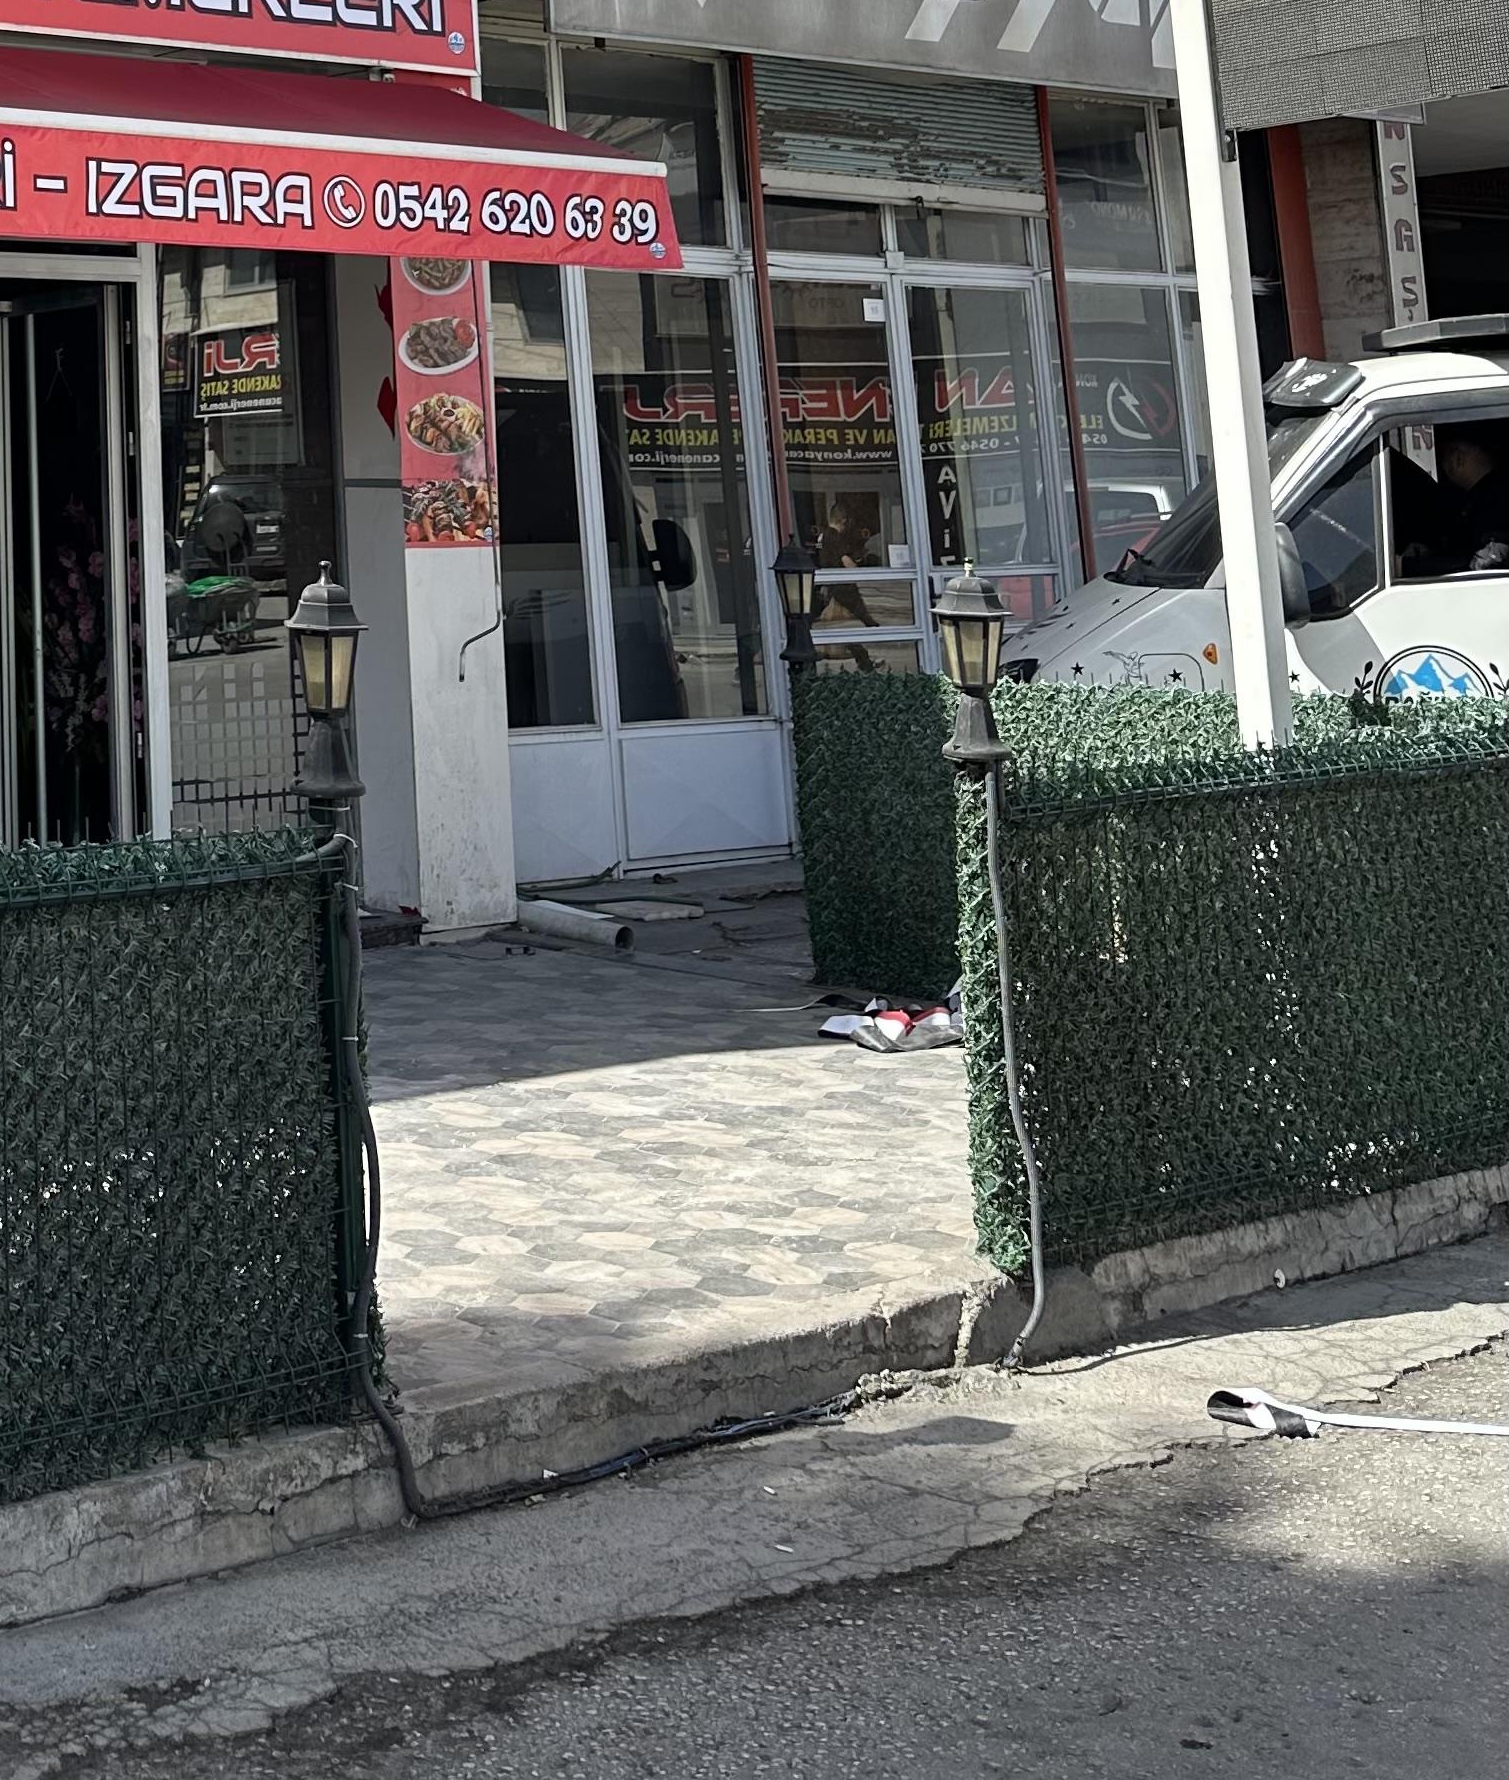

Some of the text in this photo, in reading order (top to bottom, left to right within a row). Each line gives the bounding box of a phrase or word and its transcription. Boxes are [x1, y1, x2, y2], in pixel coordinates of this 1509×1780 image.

[84, 157, 314, 229] IZGARA
[371, 178, 470, 235] 0542
[479, 186, 556, 239] 620
[562, 192, 604, 242] 63
[610, 195, 659, 245] 39
